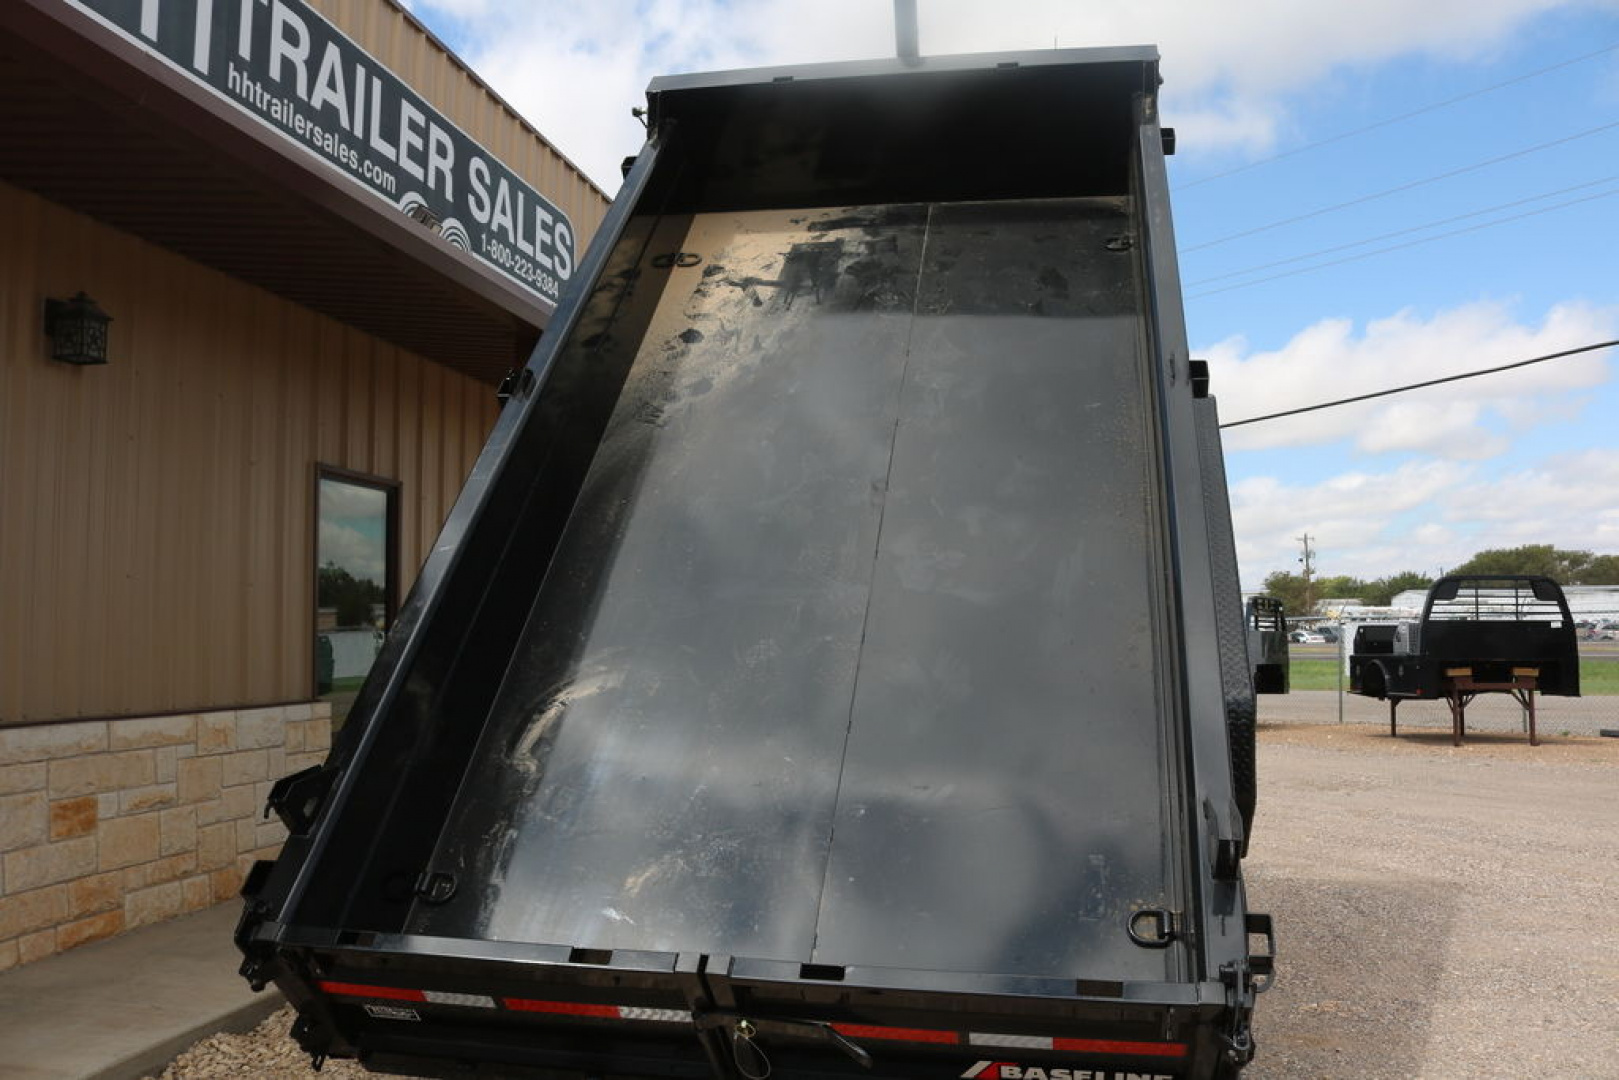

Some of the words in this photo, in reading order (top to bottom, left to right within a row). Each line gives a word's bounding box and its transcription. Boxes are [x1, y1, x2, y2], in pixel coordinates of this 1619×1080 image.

[228, 61, 397, 194] hhtrailersales.com
[237, 0, 455, 203] TRAILER
[467, 156, 572, 281] SALES
[480, 232, 559, 299] 1-800-223-9384
